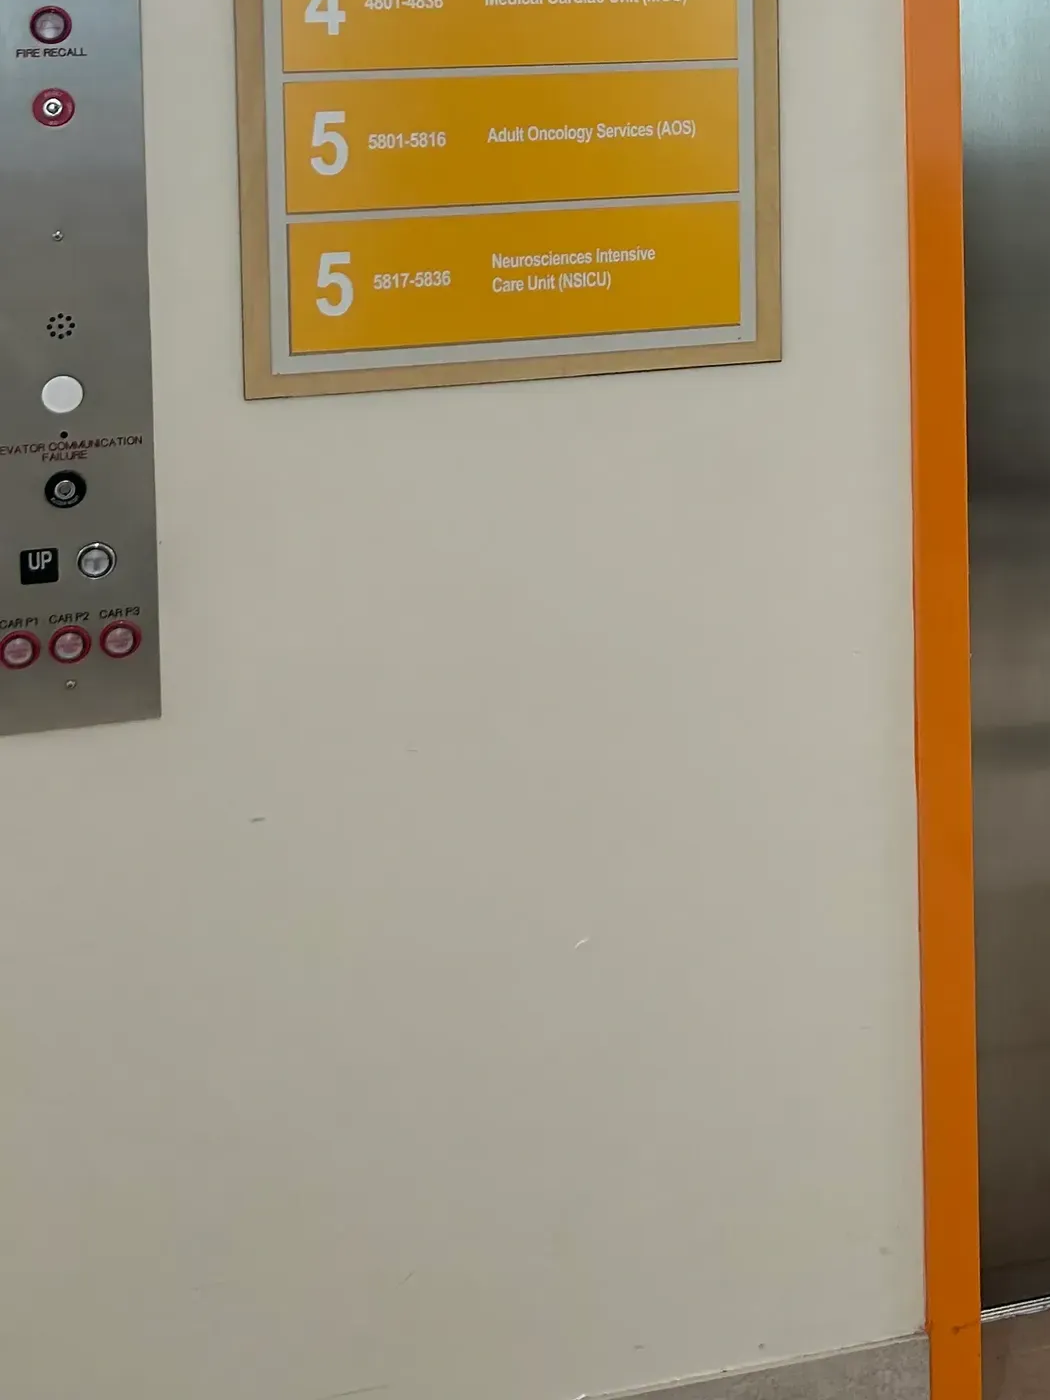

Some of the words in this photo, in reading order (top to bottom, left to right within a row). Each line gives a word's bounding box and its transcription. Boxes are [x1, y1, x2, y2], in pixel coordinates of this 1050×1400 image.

[15, 49, 40, 58] FIRE
[43, 48, 87, 58] RECALL
[368, 131, 446, 150] 5801-5816
[487, 125, 524, 143] Adult
[527, 124, 593, 144] Oncology
[596, 121, 653, 140] Services
[656, 119, 696, 140] (AOS)
[310, 111, 349, 175] 5
[492, 249, 593, 269] Neurosciences
[596, 246, 656, 264] Intensive
[316, 252, 353, 317] 5
[373, 270, 451, 290] 5817-5836
[492, 276, 524, 293] Care
[527, 274, 556, 291] Unit
[558, 271, 611, 293] (NSICU)
[48, 436, 143, 451] COMMUNICATION
[42, 450, 88, 462] FAILURE
[28, 551, 53, 571] UP
[48, 613, 73, 624] CAR
[75, 611, 90, 622] P2
[100, 608, 124, 620] CAR
[125, 606, 140, 617] P3
[0, 618, 23, 629] CAR
